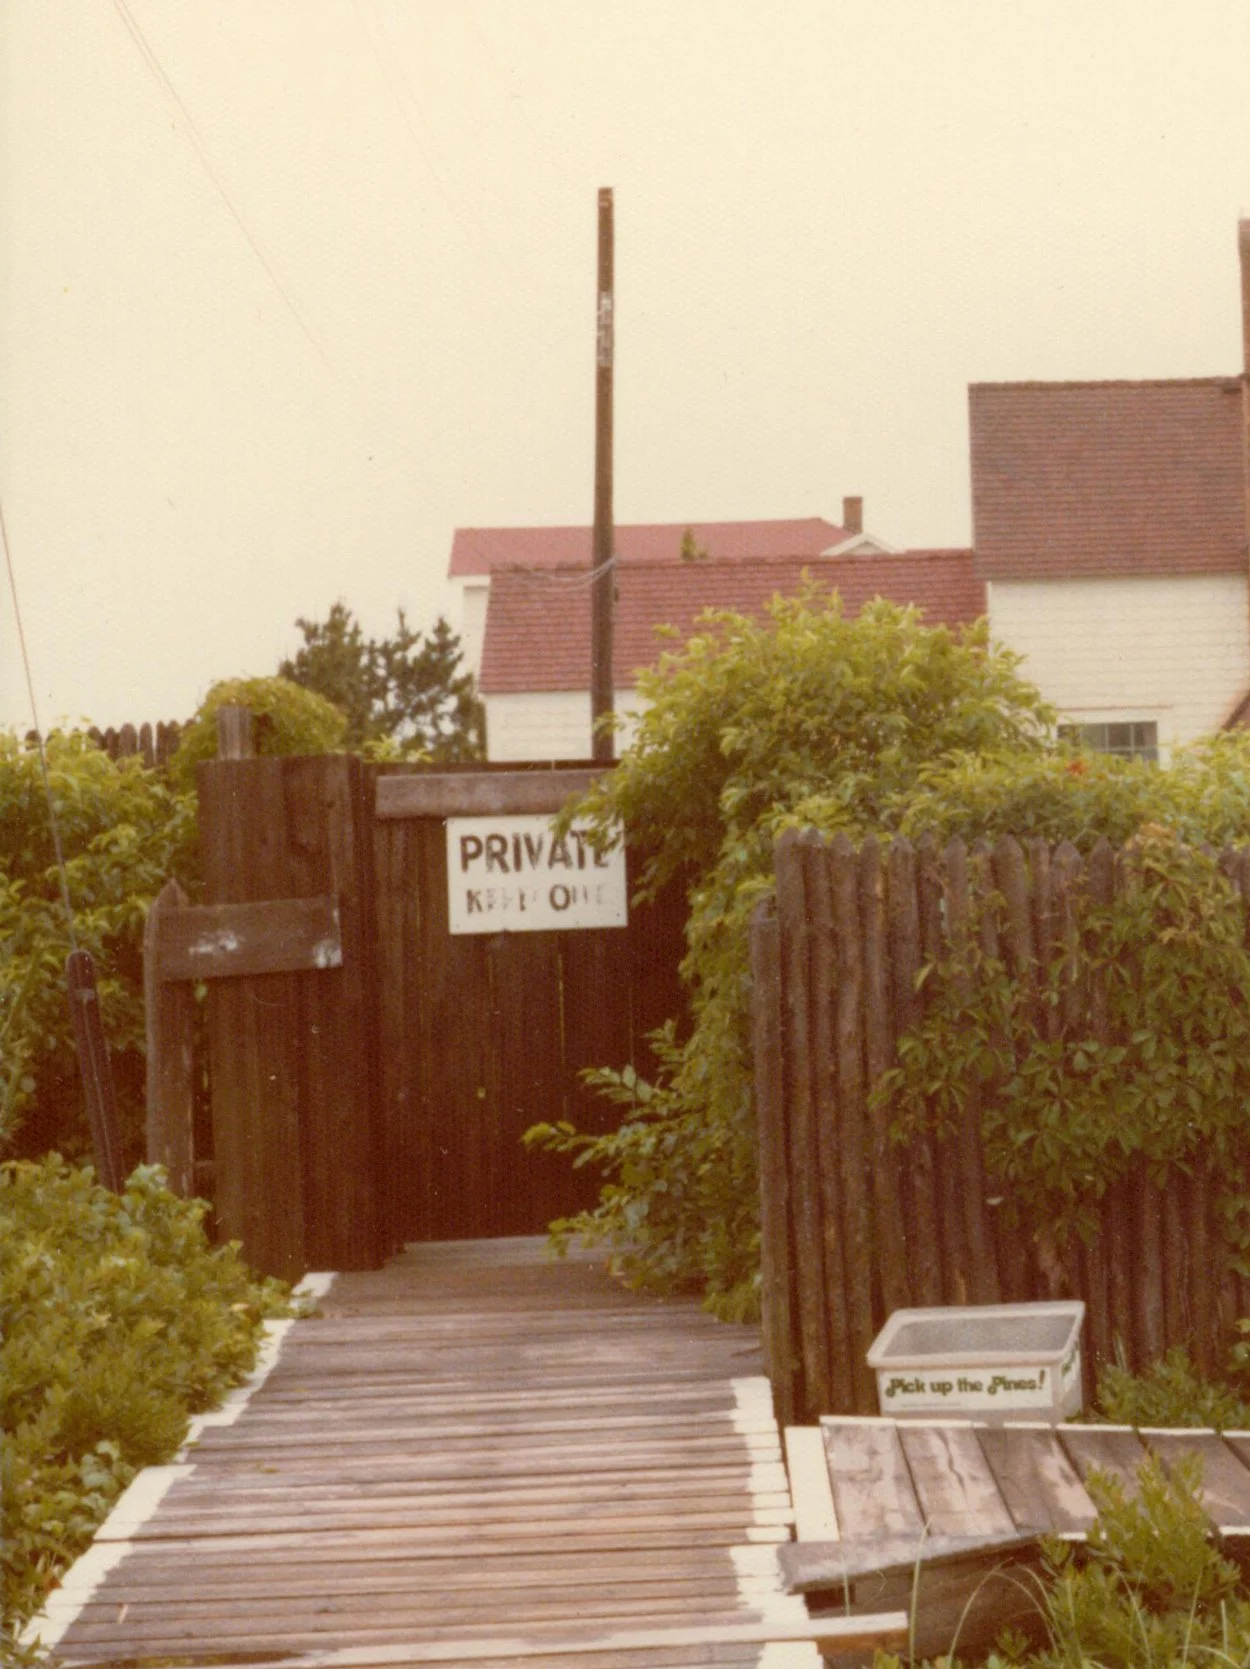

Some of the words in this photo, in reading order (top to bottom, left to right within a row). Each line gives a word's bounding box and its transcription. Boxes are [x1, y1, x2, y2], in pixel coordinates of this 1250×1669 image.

[885, 1376, 926, 1398] Pick
[930, 1381, 953, 1397] up
[956, 1377, 984, 1393] the
[987, 1369, 1047, 1396] Pines!
